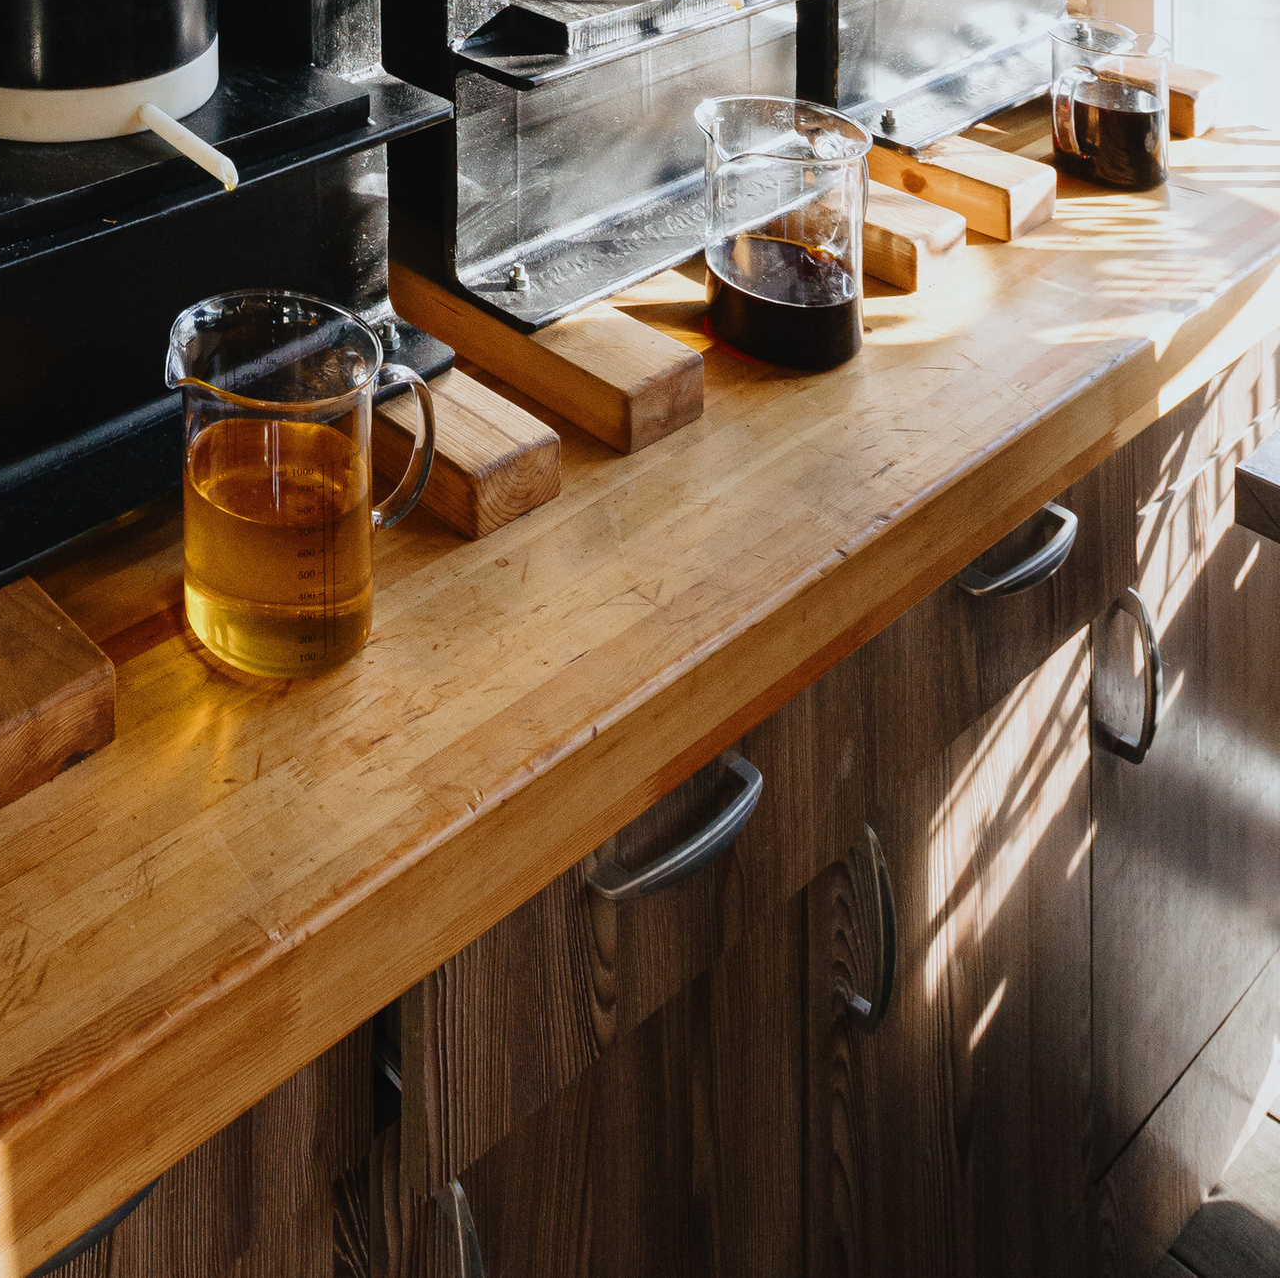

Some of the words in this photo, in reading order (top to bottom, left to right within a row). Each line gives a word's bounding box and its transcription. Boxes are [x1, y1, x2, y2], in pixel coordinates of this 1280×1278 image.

[292, 467, 315, 477] 1000
[297, 548, 315, 558] 600
[298, 569, 316, 580] 500
[298, 591, 316, 601] 400
[299, 652, 316, 663] 100
